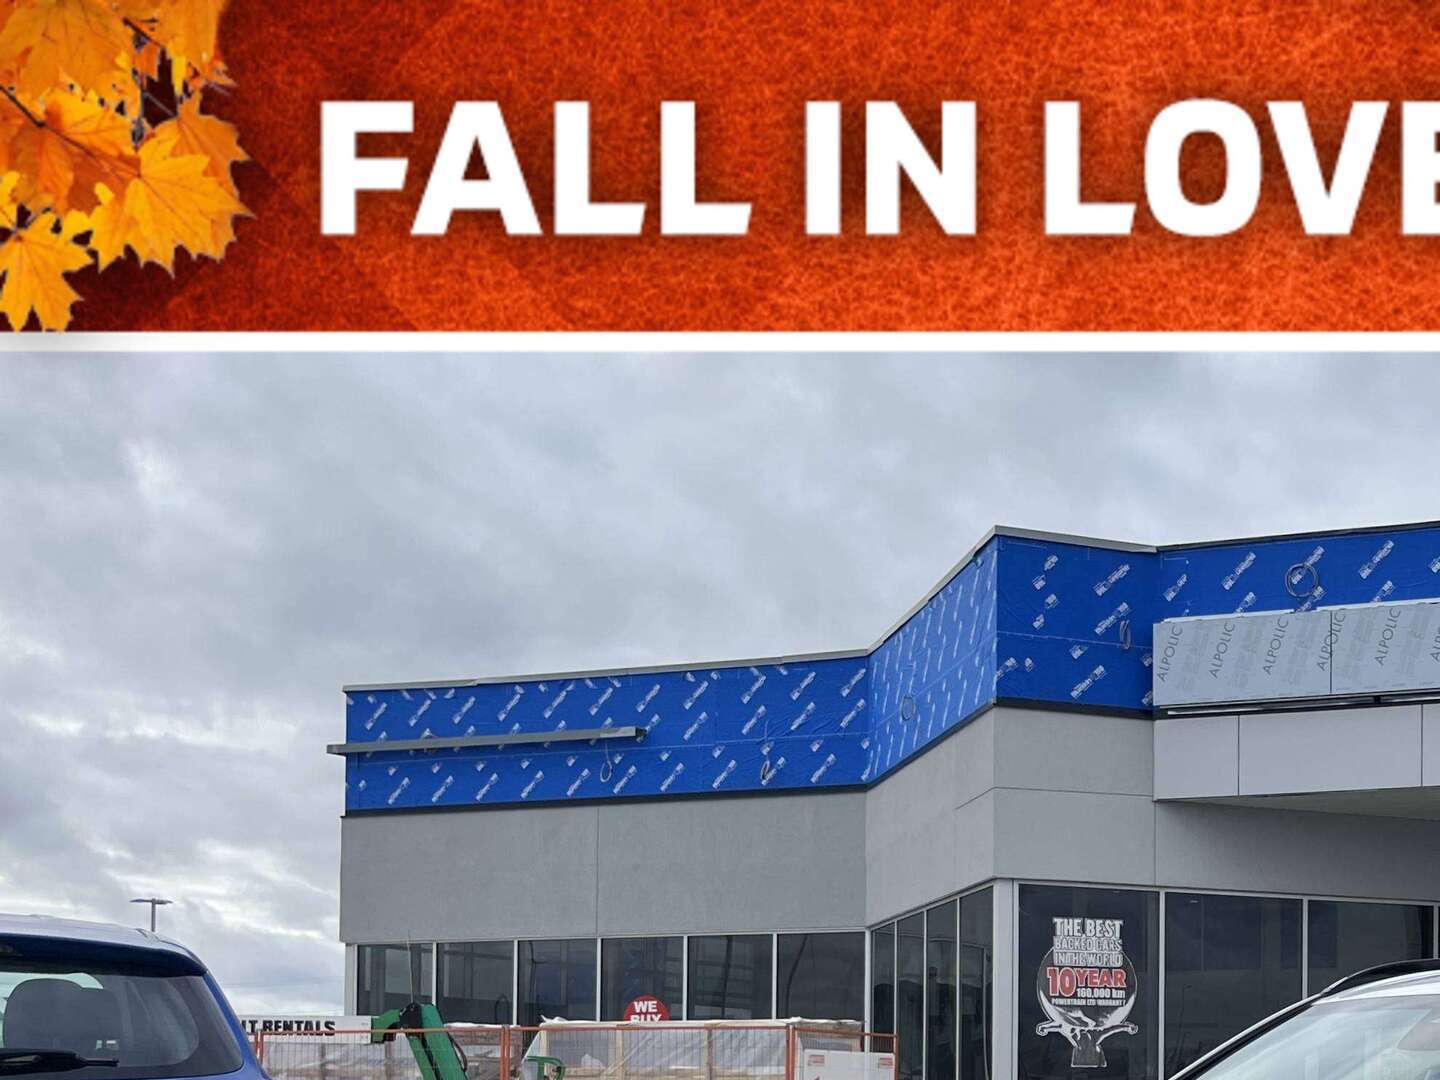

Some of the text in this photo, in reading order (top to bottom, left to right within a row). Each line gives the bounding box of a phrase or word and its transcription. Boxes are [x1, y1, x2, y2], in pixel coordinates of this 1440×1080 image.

[1263, 618, 1289, 676] ALPOLIC
[1374, 607, 1401, 666] ALPOLIC
[1157, 626, 1183, 682] ALPOLIC
[1208, 622, 1235, 679] ALPOLIC
[1053, 918, 1124, 939] THE BEST
[1055, 938, 1123, 952] BACKED CARS
[1087, 953, 1124, 967] WORLD
[1046, 967, 1126, 997] 10 YEAR
[1112, 988, 1126, 998] km
[633, 1001, 658, 1013] WE
[262, 1020, 336, 1036] RENTALS
